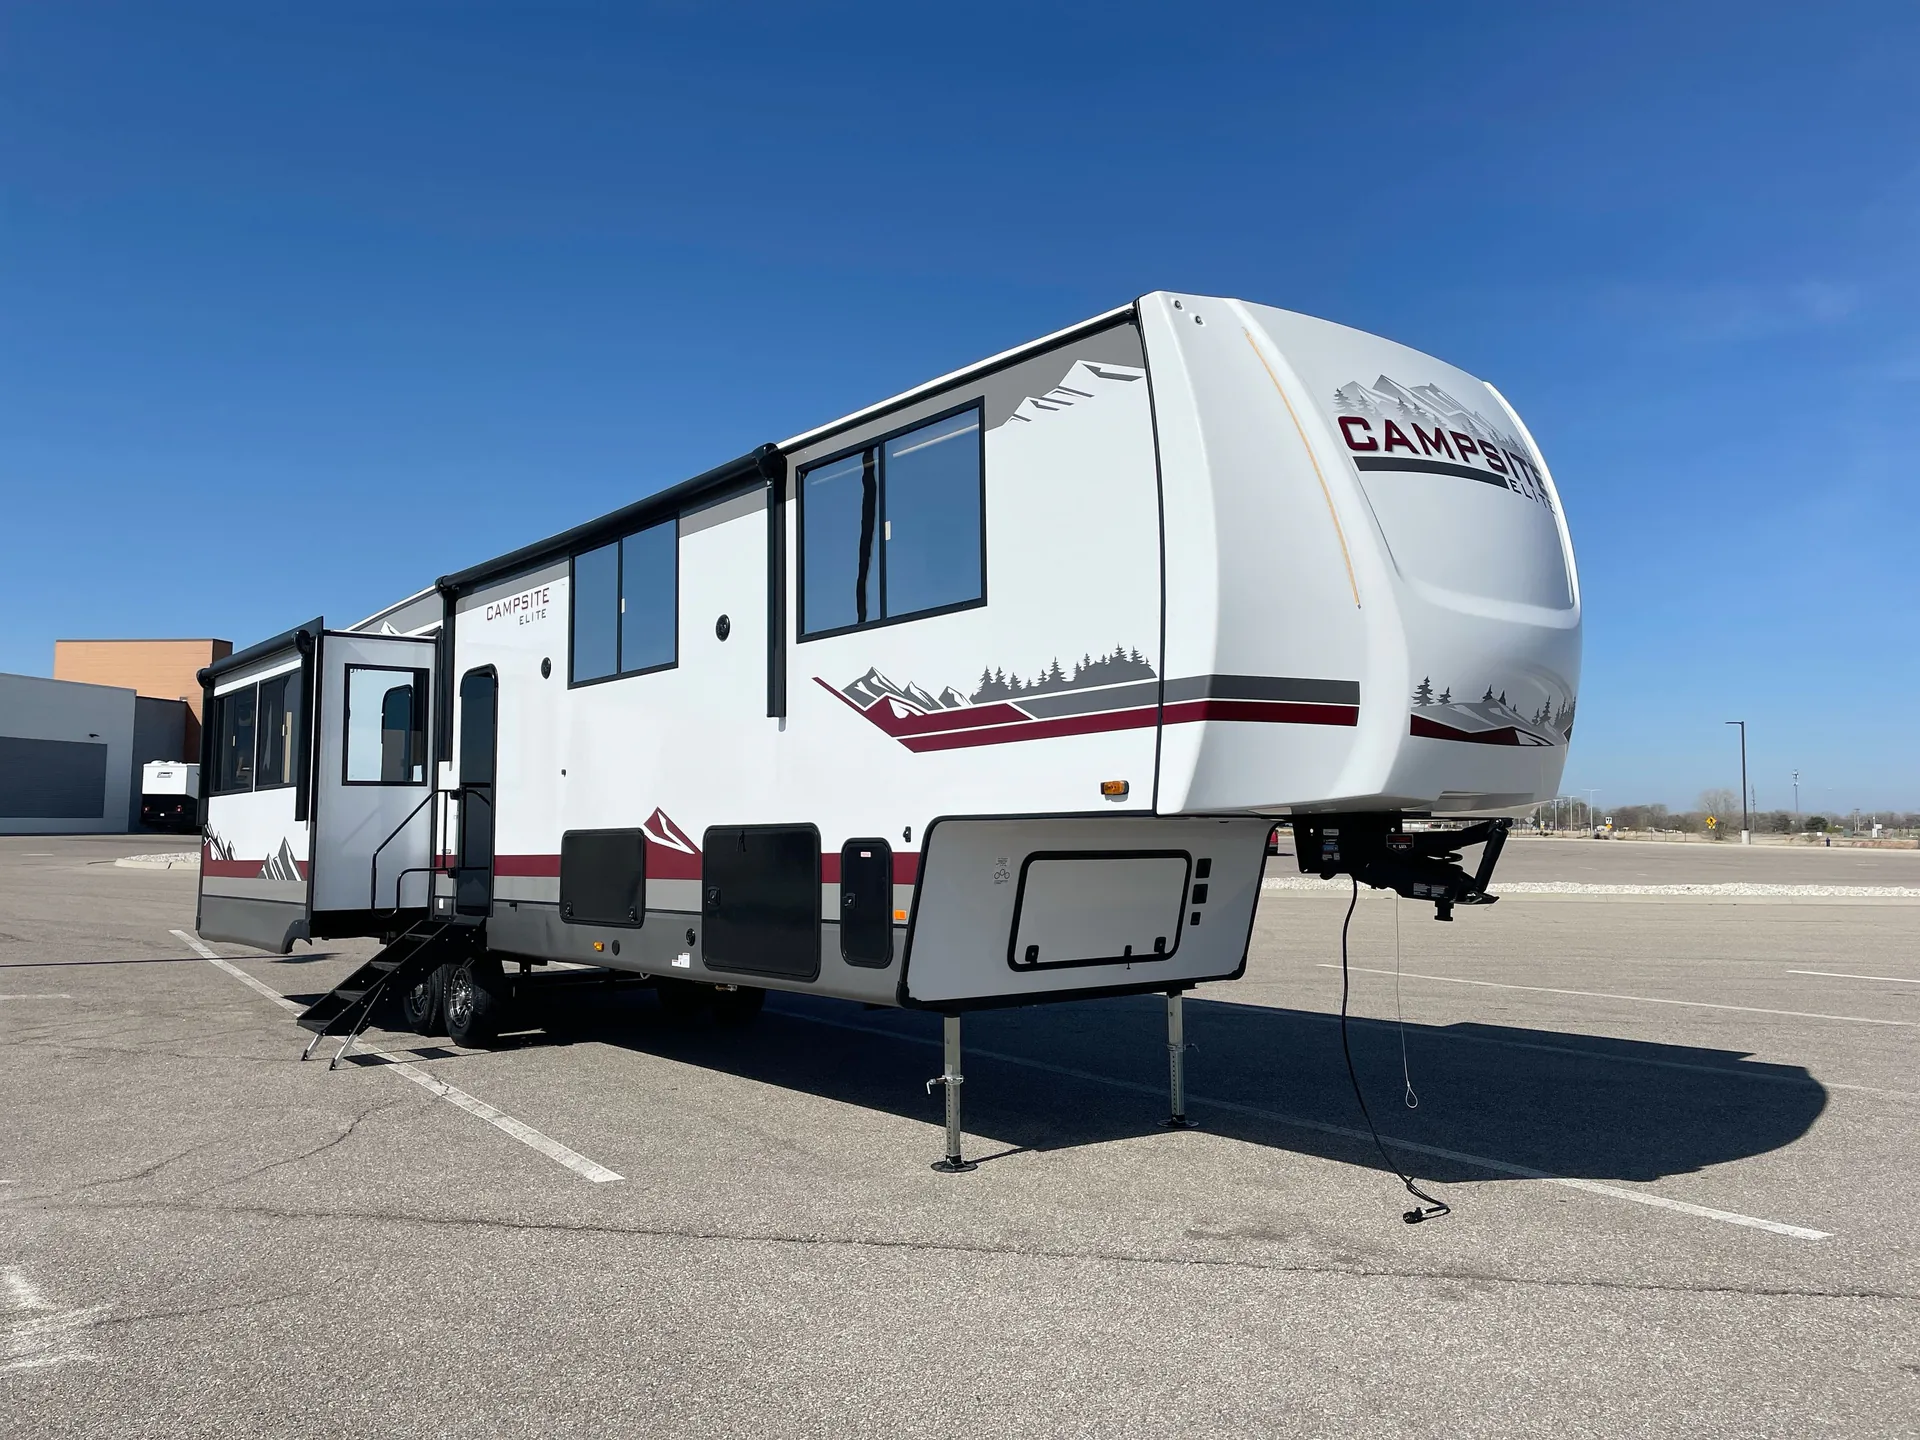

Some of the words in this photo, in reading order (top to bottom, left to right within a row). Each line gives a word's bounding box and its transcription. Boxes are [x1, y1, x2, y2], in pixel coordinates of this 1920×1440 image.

[1337, 415, 1549, 499] CAMPSITE
[1508, 478, 1556, 515] ELITE
[486, 587, 550, 621] CAMPSITE
[519, 608, 547, 626] ELITE
